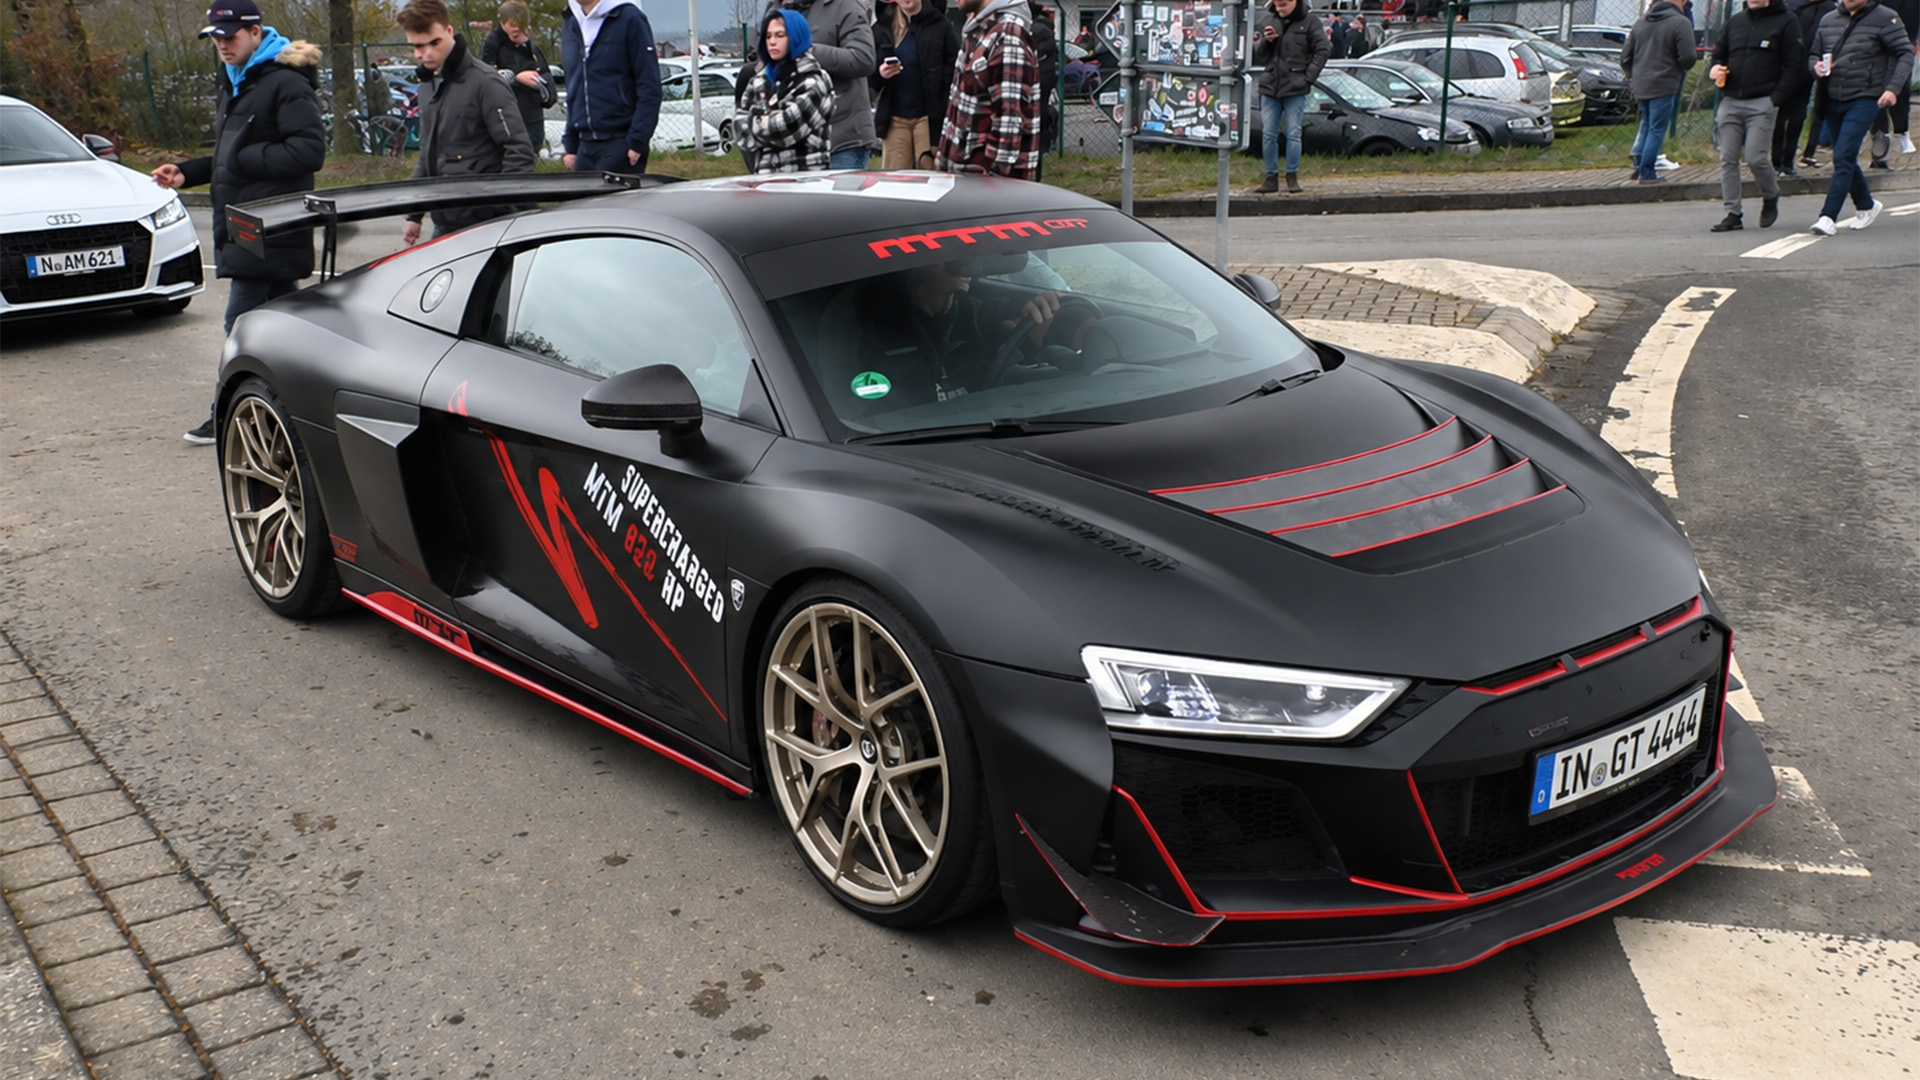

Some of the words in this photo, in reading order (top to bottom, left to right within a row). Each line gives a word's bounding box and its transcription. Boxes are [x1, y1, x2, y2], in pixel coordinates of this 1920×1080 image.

[41, 257, 53, 273] N
[64, 253, 86, 271] AM
[88, 250, 116, 267] 621
[583, 461, 624, 533] MTM
[661, 569, 685, 612] HP
[621, 464, 724, 623] SUPERCHARGED
[1555, 748, 1593, 801] IN
[1610, 727, 1646, 779] GT
[1647, 699, 1698, 759] 4444
